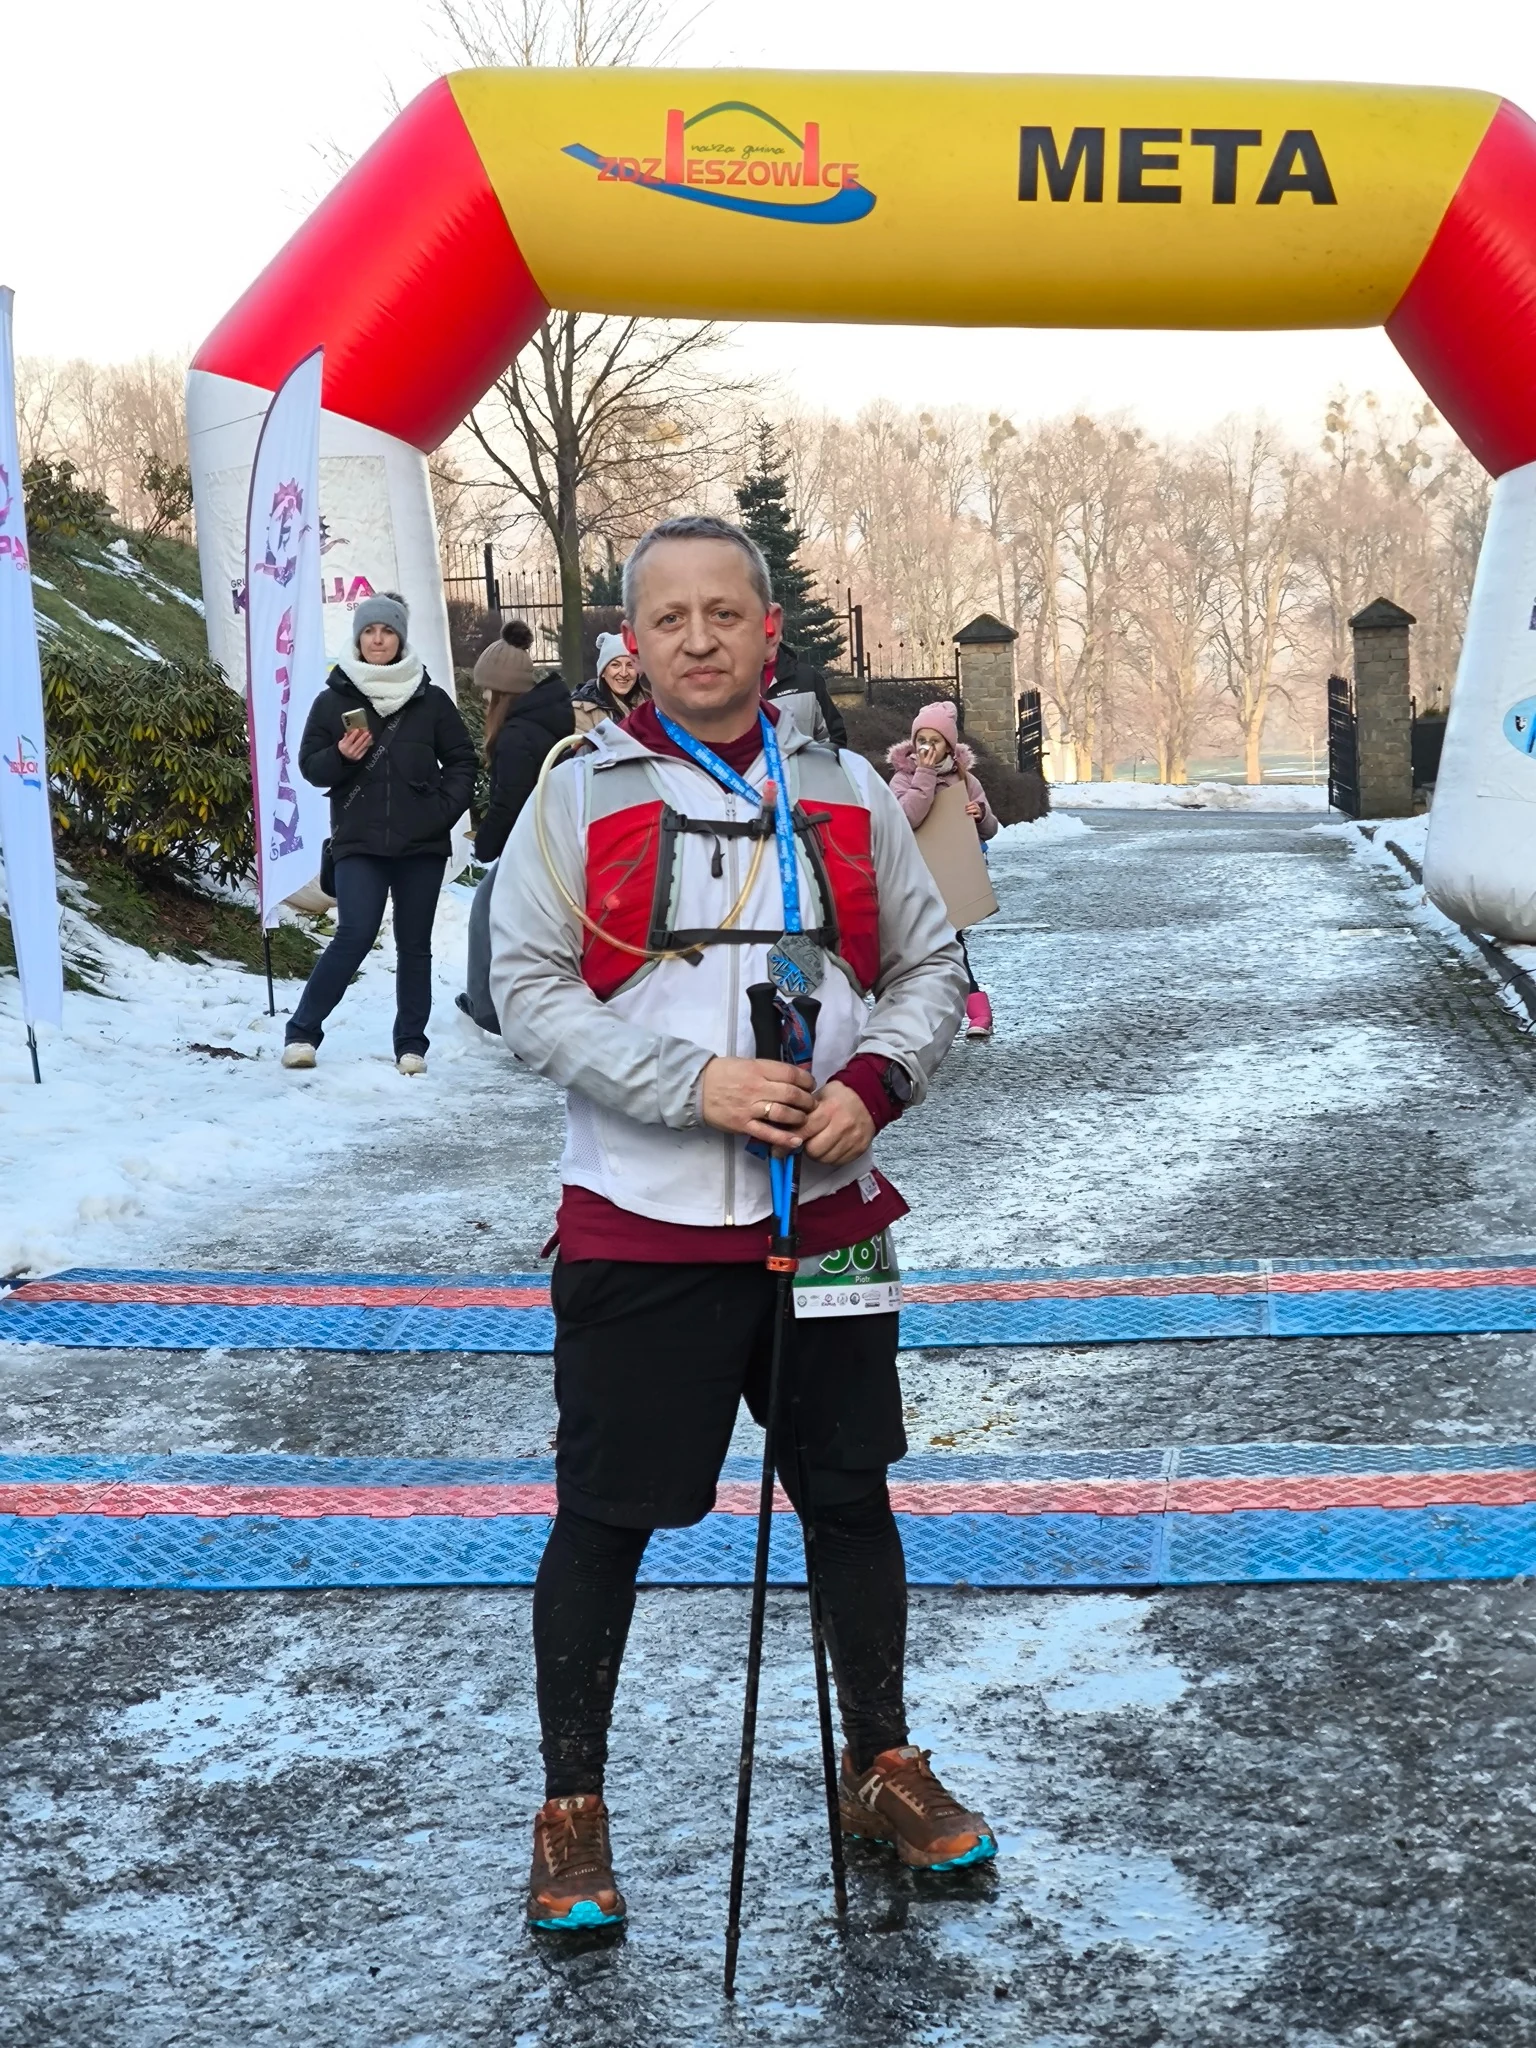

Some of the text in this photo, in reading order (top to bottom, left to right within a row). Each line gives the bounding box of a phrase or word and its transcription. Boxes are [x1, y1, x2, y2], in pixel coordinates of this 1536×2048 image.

[691, 144, 786, 160] nasza gmina
[1018, 126, 1338, 205] META
